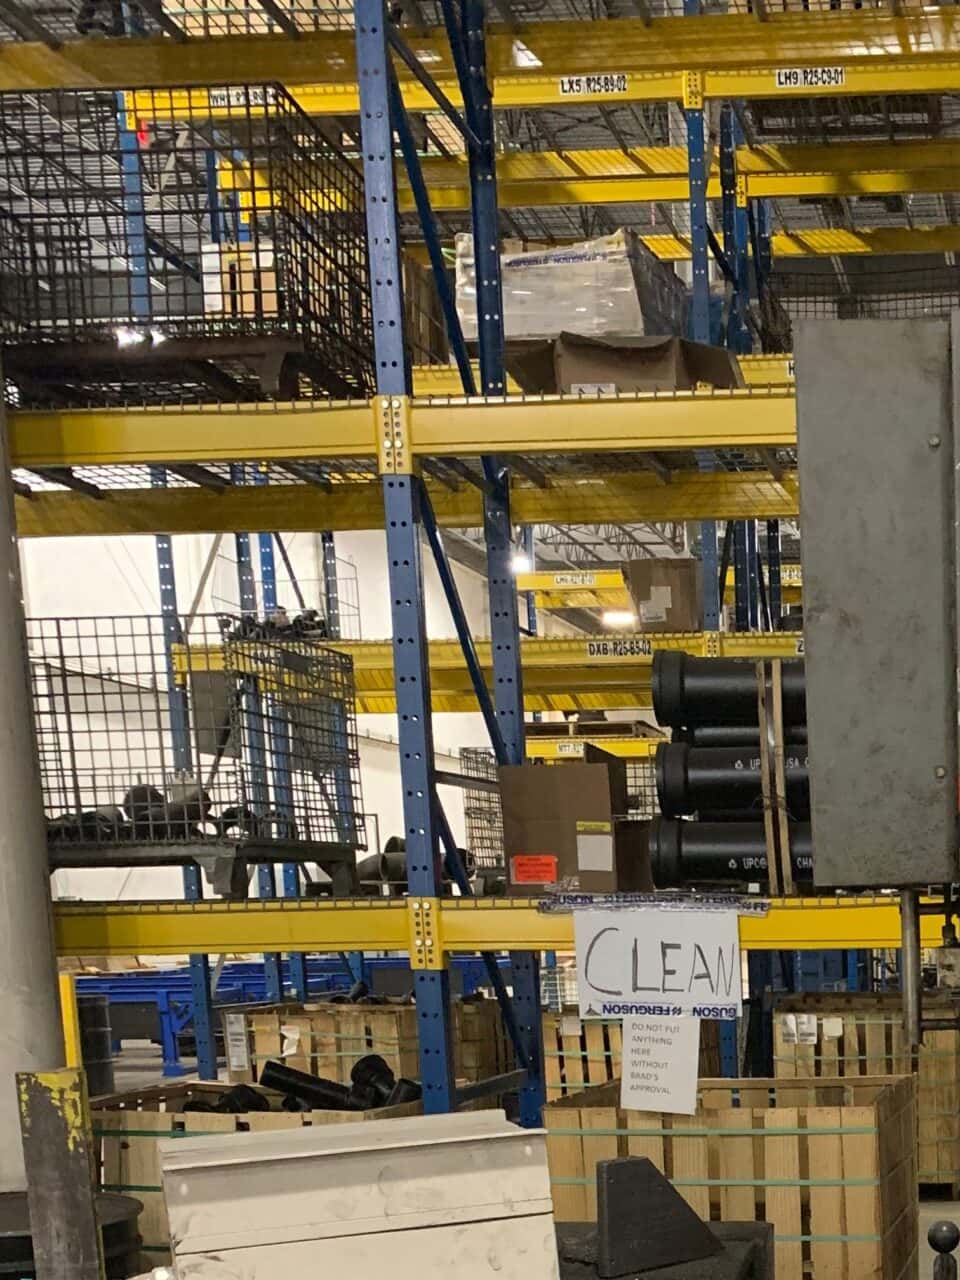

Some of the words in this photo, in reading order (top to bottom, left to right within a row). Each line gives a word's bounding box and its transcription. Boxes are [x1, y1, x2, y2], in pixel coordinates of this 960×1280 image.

[777, 71, 798, 85] LH9
[803, 68, 843, 85] R25-C9-01
[560, 78, 581, 93] LX5
[585, 74, 627, 93] R25-B9-02
[585, 927, 735, 997] CLEAN
[602, 1004, 670, 1016] FERGUSON
[631, 1022, 644, 1031] DO
[646, 1023, 662, 1032] NOT
[665, 1025, 680, 1033] PUT
[631, 1035, 672, 1045] ANYTHING
[631, 1047, 650, 1056] HERE
[631, 1060, 668, 1069] WITHOUT
